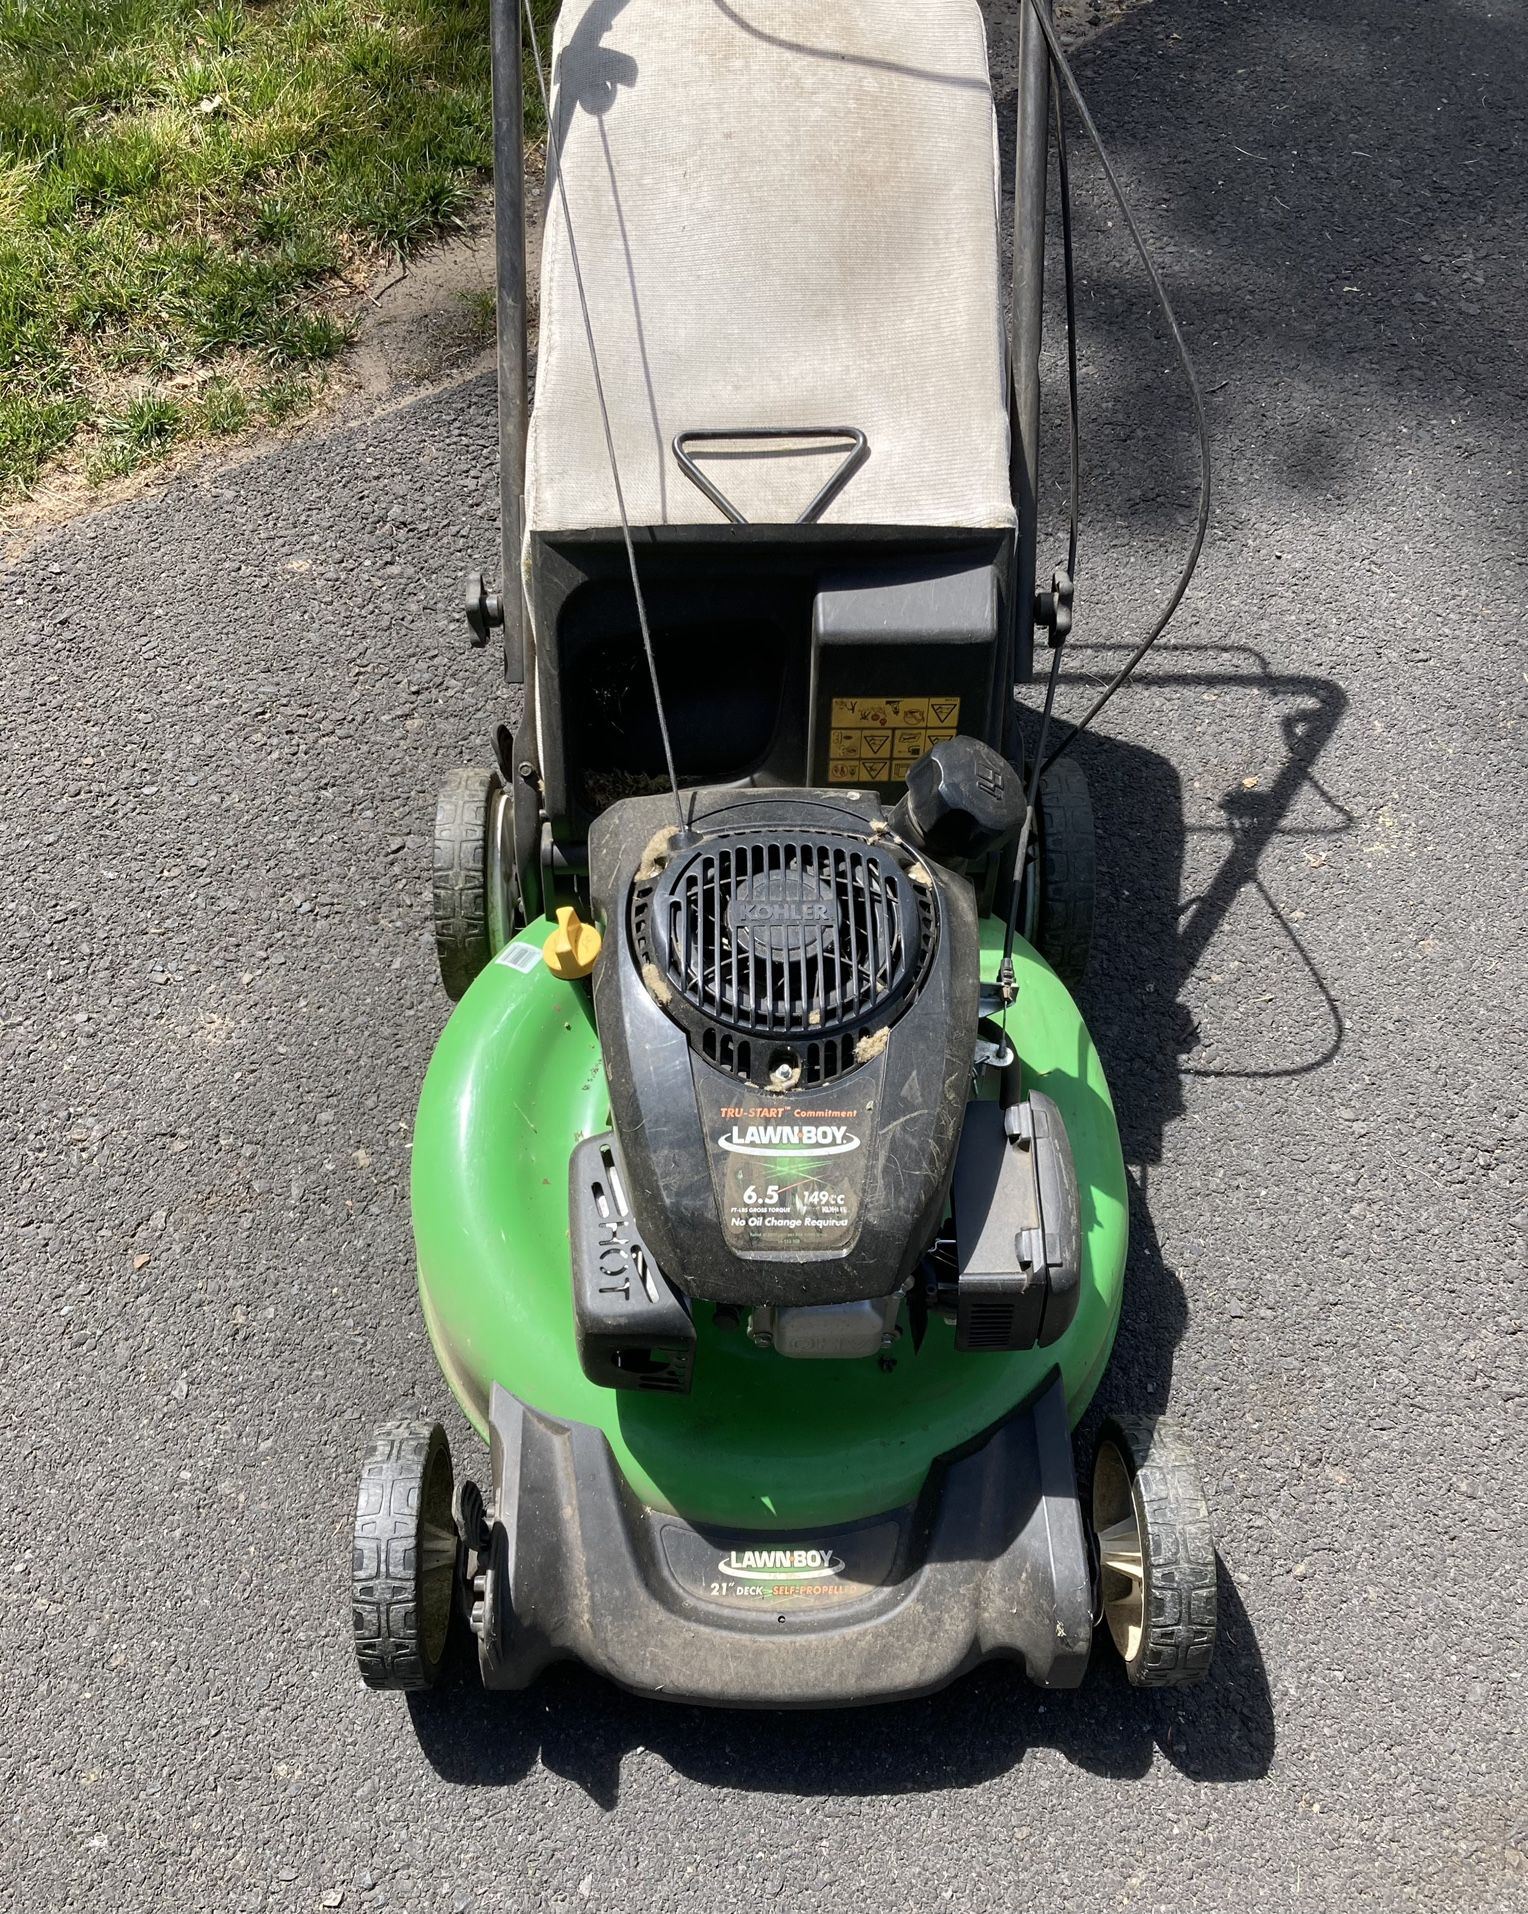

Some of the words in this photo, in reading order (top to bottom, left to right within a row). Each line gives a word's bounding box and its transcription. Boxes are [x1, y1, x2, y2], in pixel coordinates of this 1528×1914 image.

[741, 905, 829, 921] KOHLER
[794, 1109, 857, 1118] Commitment
[743, 1185, 779, 1205] 6.5
[731, 1218, 746, 1227] No
[748, 1217, 762, 1227] Oil
[765, 1217, 802, 1229] Change
[598, 1221, 630, 1301] HOT
[736, 1586, 763, 1596] DECK
